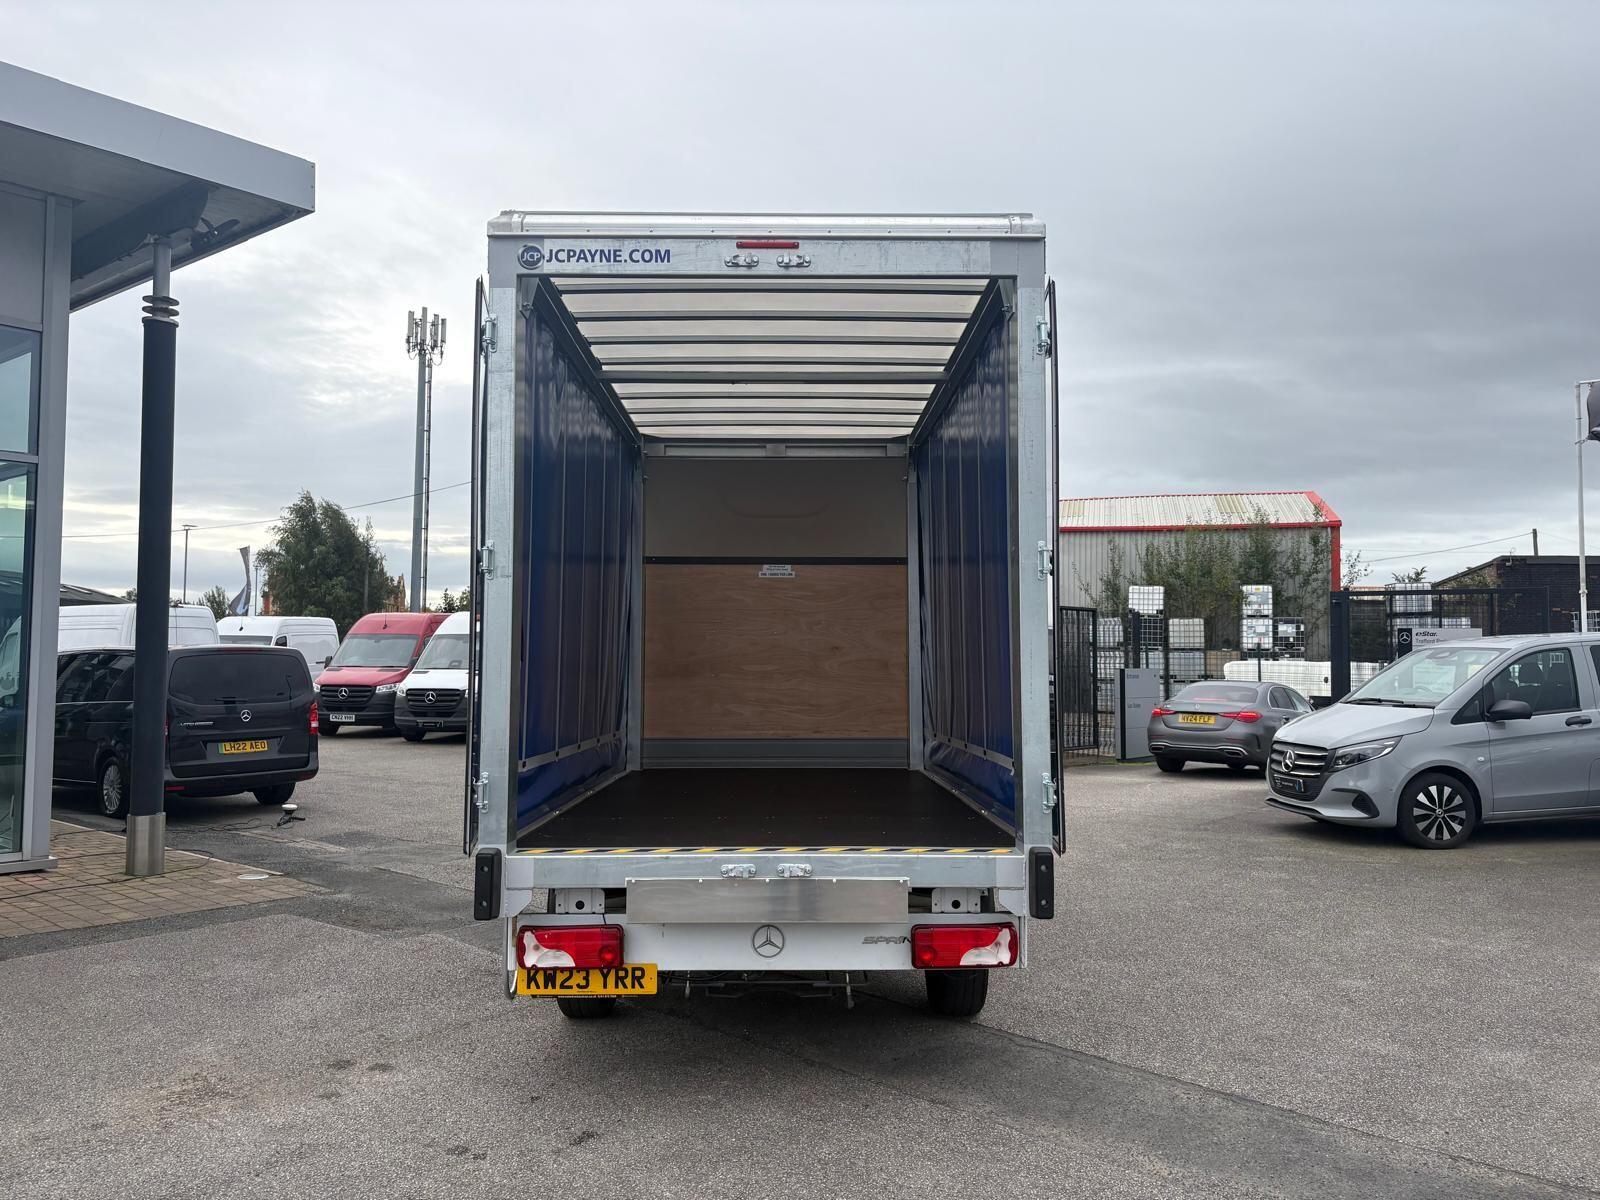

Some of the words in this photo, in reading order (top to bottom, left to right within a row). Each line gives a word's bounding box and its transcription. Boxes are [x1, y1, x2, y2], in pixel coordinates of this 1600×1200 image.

[522, 251, 541, 262] JCP
[546, 248, 671, 264] JCPAYNE.COM
[224, 742, 247, 752] LH22
[526, 967, 590, 990] KW23
[599, 966, 646, 990] YRR
